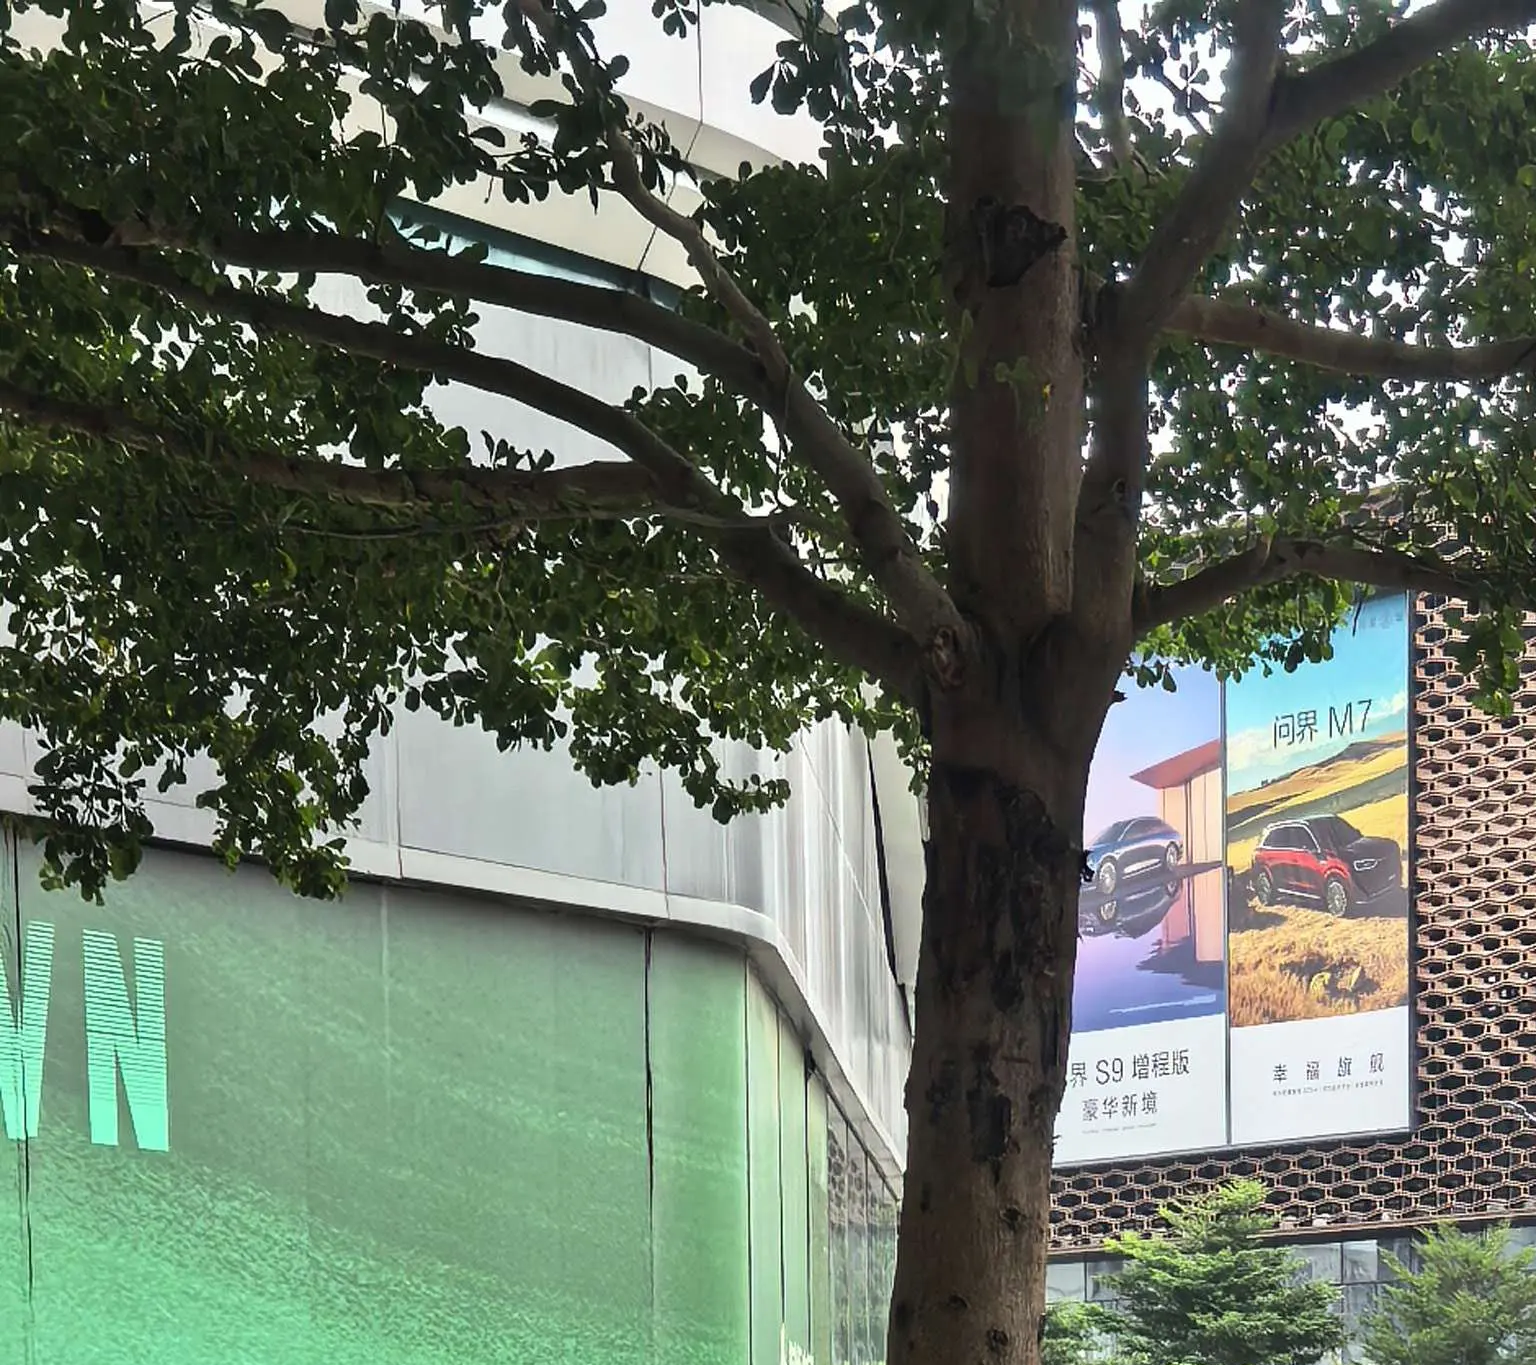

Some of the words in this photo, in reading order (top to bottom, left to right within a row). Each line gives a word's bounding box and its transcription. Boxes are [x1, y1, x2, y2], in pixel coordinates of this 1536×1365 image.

[1273, 709, 1319, 749] 问界
[1328, 698, 1373, 739] M7
[1095, 1056, 1125, 1086] S9
[1131, 1048, 1191, 1081] 增程版
[1081, 1089, 1159, 1122] 豪华新境
